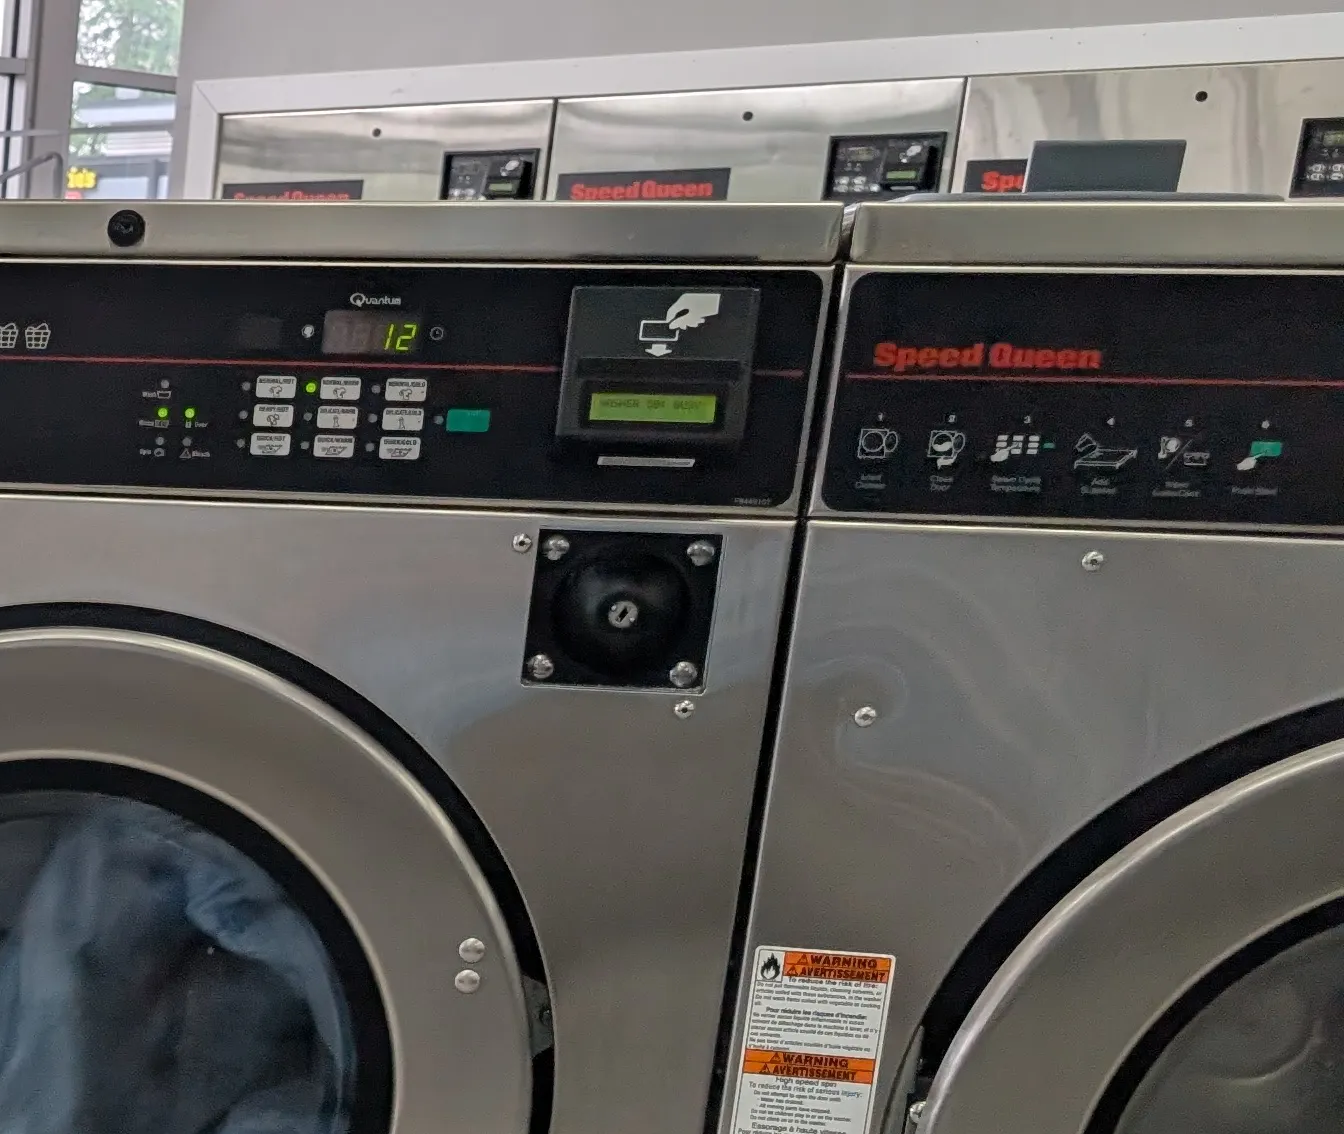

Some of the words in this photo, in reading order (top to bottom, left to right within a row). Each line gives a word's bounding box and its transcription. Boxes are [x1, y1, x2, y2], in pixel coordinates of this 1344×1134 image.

[571, 183, 640, 200] Speed
[642, 180, 713, 199] Queen
[349, 292, 402, 308] Quantum
[384, 323, 417, 352] 12
[874, 342, 984, 372] Speed
[988, 342, 1103, 370] Queen
[810, 954, 877, 968] WARNING
[782, 1053, 849, 1068] WARNING
